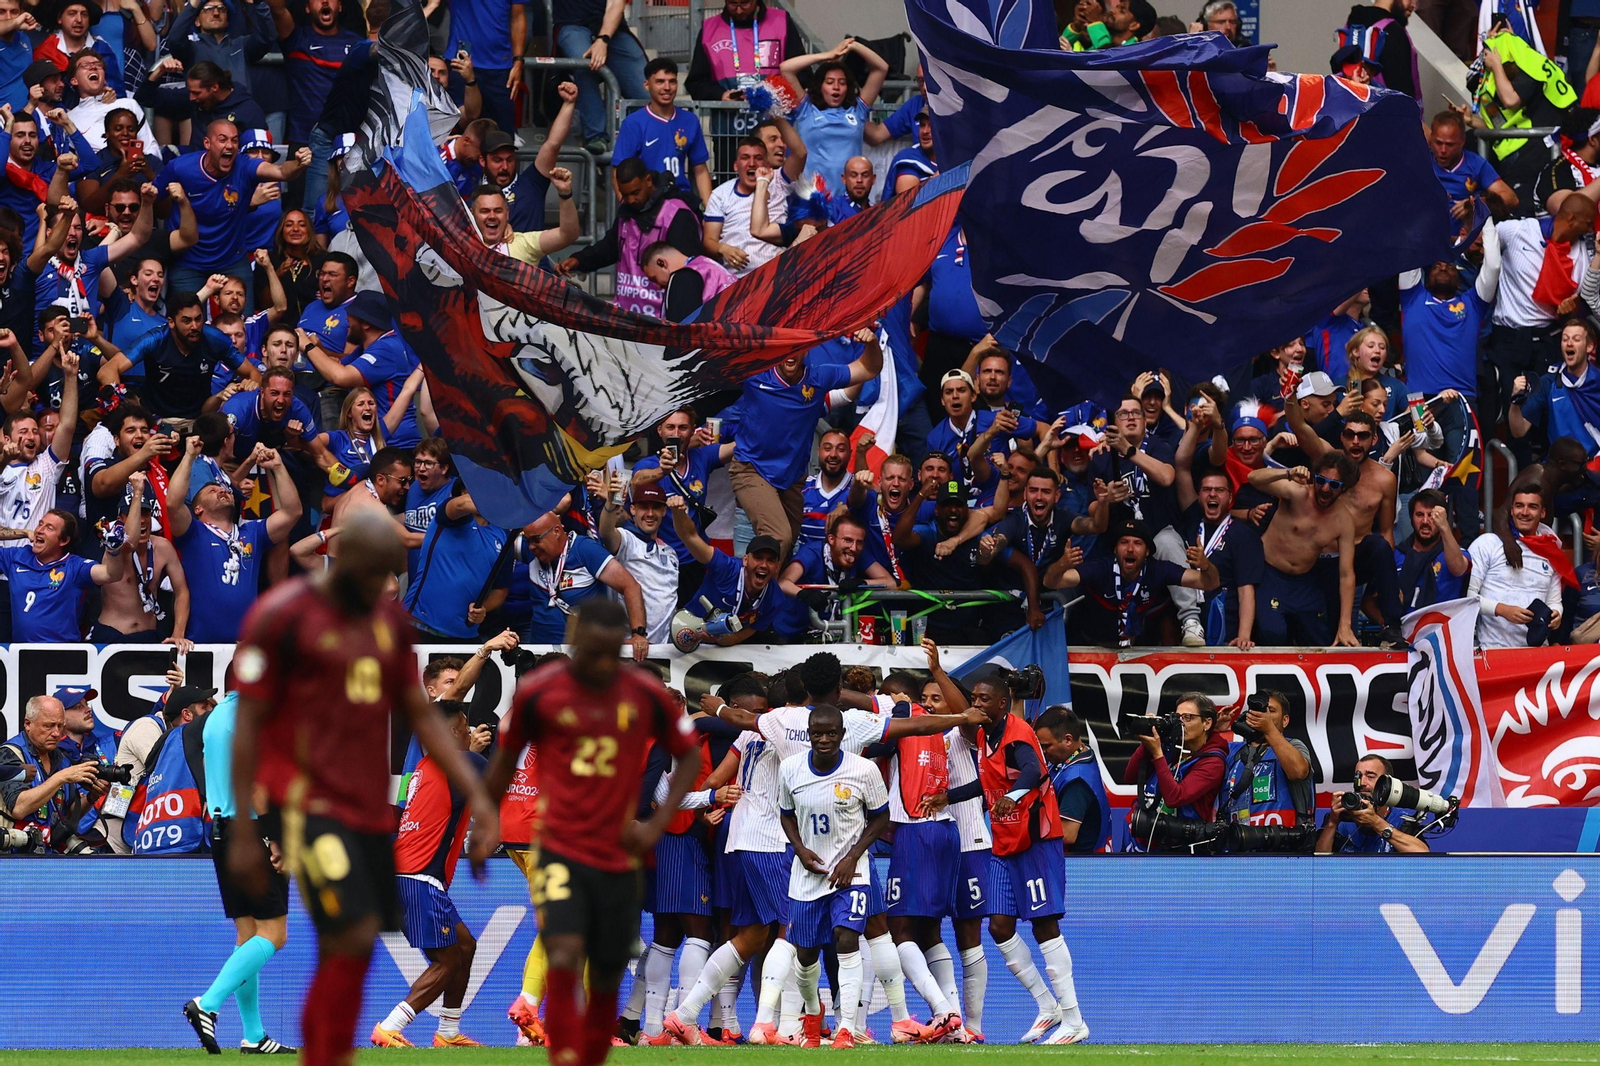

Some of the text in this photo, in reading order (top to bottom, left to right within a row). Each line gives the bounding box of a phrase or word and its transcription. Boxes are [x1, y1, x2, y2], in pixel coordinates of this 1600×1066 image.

[664, 156, 681, 178] 10
[617, 285, 665, 301] SUPPORT
[24, 591, 36, 613] 9
[571, 735, 619, 778] 22
[1252, 785, 1269, 794] 065
[811, 813, 831, 836] 13
[887, 877, 902, 902] 15
[967, 877, 982, 901] 5
[1026, 878, 1047, 903] 11
[850, 890, 867, 916] 13
